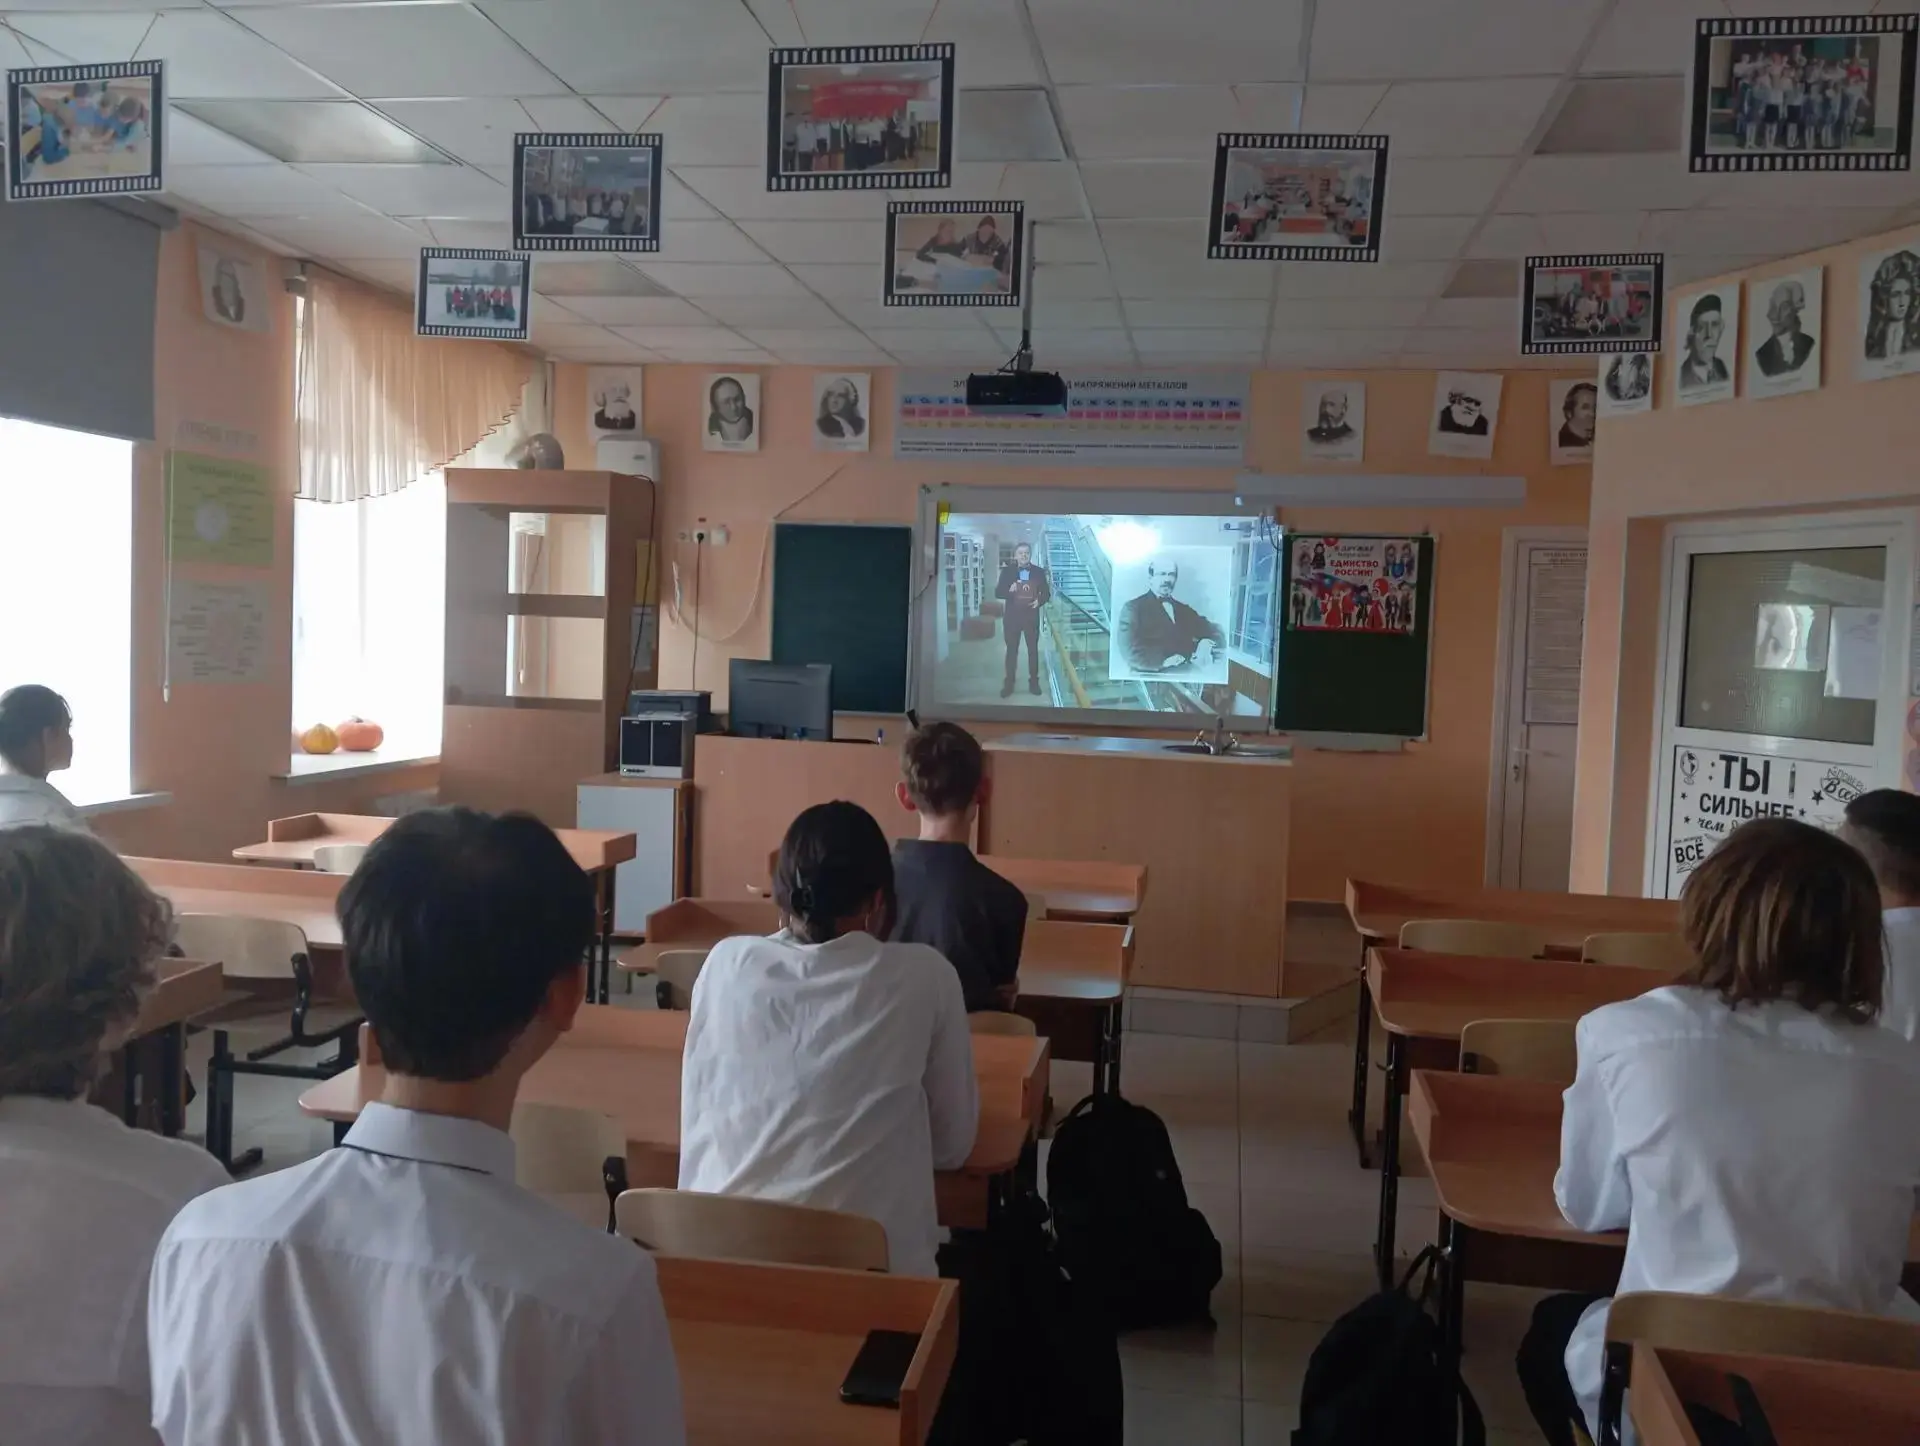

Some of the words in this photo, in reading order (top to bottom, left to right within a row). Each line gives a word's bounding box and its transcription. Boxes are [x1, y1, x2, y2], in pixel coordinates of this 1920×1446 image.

[1138, 381, 1188, 390] МЕТАЛЛОВ
[1330, 560, 1379, 568] ЕДИНСТВО
[1334, 569, 1374, 577] РОССИИ!
[1719, 754, 1771, 795] ТЫ
[1699, 792, 1795, 820] СИЛЬНЕЕ
[1698, 817, 1726, 833] чем
[1675, 839, 1705, 864] ВСЁ
